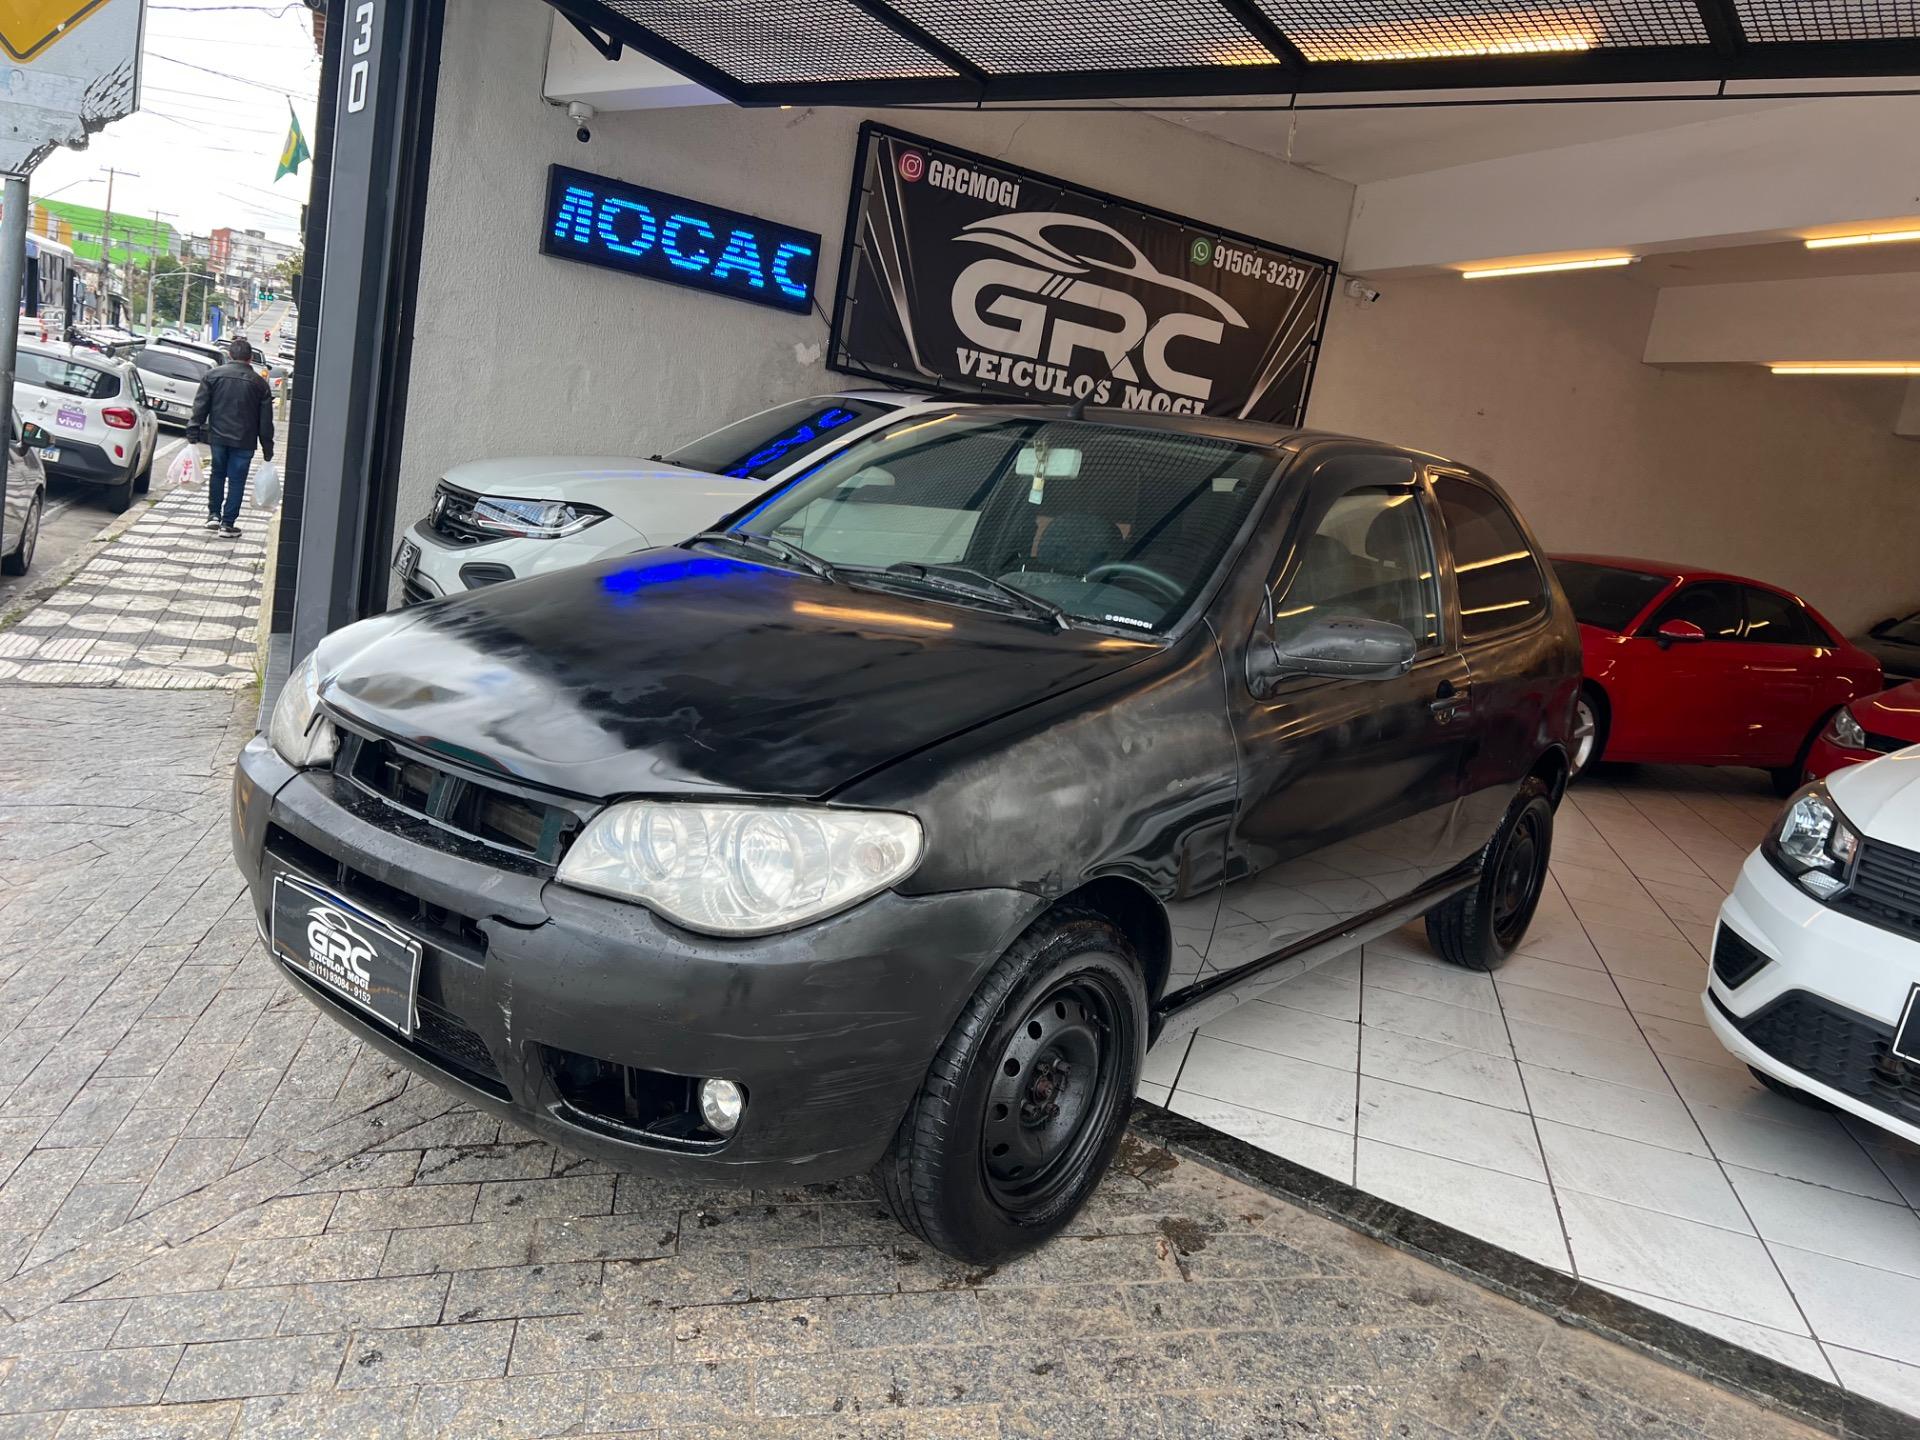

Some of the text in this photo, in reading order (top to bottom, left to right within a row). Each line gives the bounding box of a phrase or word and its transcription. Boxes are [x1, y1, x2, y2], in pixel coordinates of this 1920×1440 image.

[928, 159, 1020, 209] GRCMOGI
[1212, 245, 1306, 291] 91564-3237
[951, 258, 1225, 401] GRC
[956, 347, 1207, 415] VEICULOS MOGI
[58, 416, 83, 428] vivo
[307, 920, 372, 982] GRC
[309, 947, 369, 990] VEICULOS MOGI
[316, 963, 329, 980] (11)
